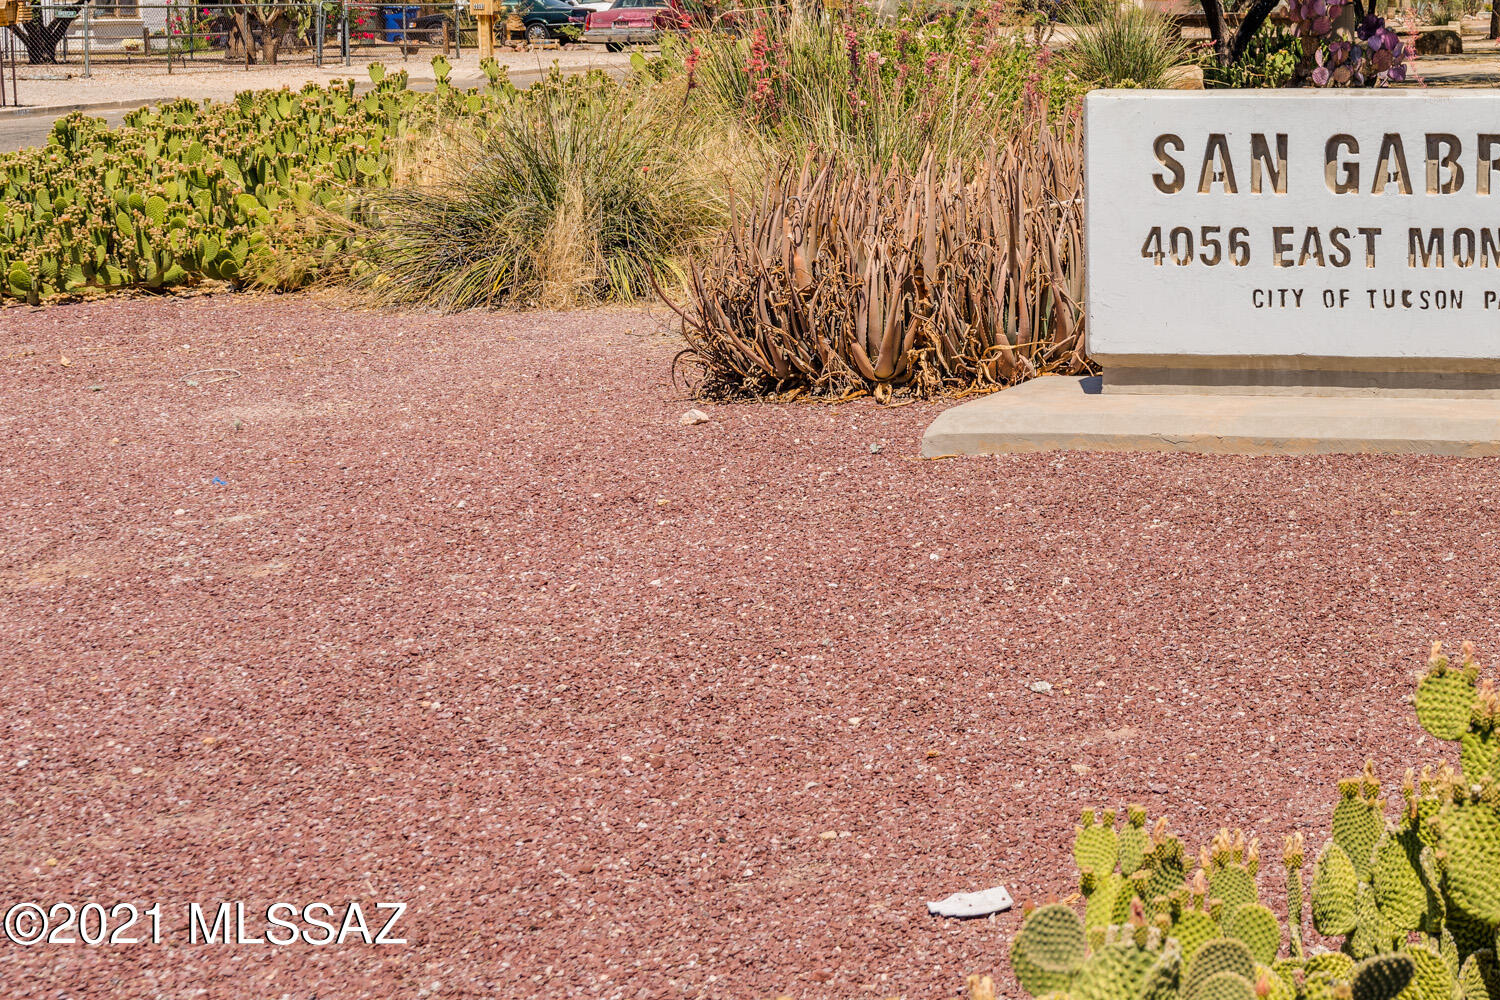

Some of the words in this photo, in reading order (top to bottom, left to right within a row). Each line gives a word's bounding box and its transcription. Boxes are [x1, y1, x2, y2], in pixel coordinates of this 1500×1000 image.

[1152, 132, 1288, 195] SAN
[1141, 225, 1251, 267] 4056
[1272, 225, 1382, 268] EAST
[1252, 288, 1304, 309] CITY
[1322, 288, 1350, 309] OF
[1366, 288, 1464, 310] TUCSON
